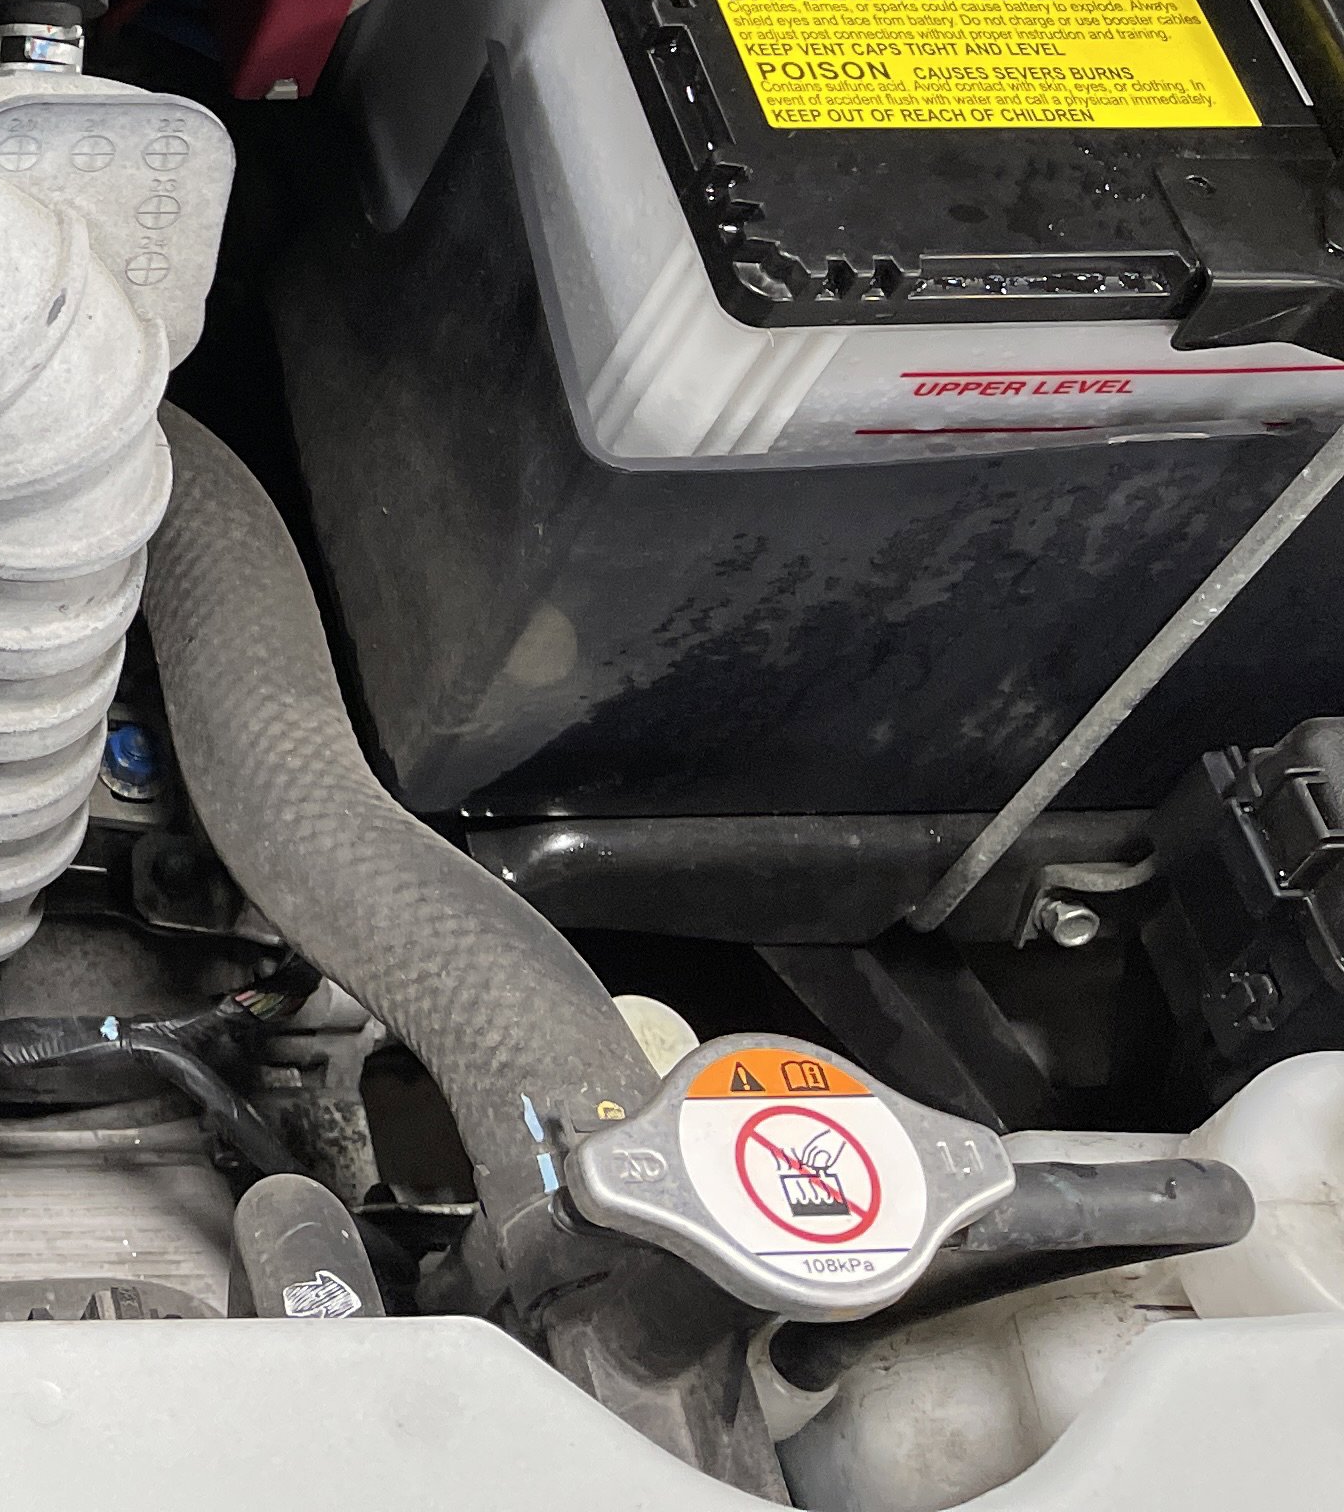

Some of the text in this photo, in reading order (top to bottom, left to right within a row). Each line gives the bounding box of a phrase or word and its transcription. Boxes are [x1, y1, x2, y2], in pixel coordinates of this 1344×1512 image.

[728, 1, 801, 14] Cigarettes,
[804, 2, 853, 13] flames,
[856, 3, 868, 12] or
[874, 2, 918, 14] sparks
[922, 1, 958, 12] could
[962, 3, 1001, 12] cause
[1005, 1, 1050, 14] battery
[1053, 1, 1067, 12] to
[1130, 0, 1177, 14] Always
[734, 15, 773, 26] shield
[777, 17, 810, 28] eyes
[813, 15, 837, 26] and
[842, 15, 870, 26] face
[874, 15, 904, 26] from
[962, 16, 980, 26] Do
[985, 16, 1004, 26] not
[1009, 15, 1054, 28] charge
[1059, 17, 1070, 26] or
[1076, 17, 1100, 26] use
[1104, 15, 1152, 25] booster
[1157, 14, 1201, 25] cables
[739, 28, 1172, 43] or adjust post connections without proper instruction and training.
[744, 43, 1066, 55] KEEP VENT CAPS TIGHT AND LEVEL
[756, 62, 1134, 80] POISON CAUSES SEVERS BURNS
[761, 80, 823, 92] Contains
[879, 80, 910, 92] acid.
[914, 80, 951, 91] Avoid
[955, 82, 1004, 91] contact
[1008, 81, 1035, 91] with
[1074, 83, 1112, 94] eyes,
[1115, 83, 1127, 91] or
[1132, 81, 1189, 94] clothing.
[1192, 80, 1205, 90] In
[767, 93, 1216, 108] event of accident flush with water and call a physician immediately.
[771, 109, 1095, 122] KEEP OUT OF REACH OF CHILDREN
[913, 379, 1133, 397] UPPER LEVEL
[803, 1258, 875, 1274] 108kPa
